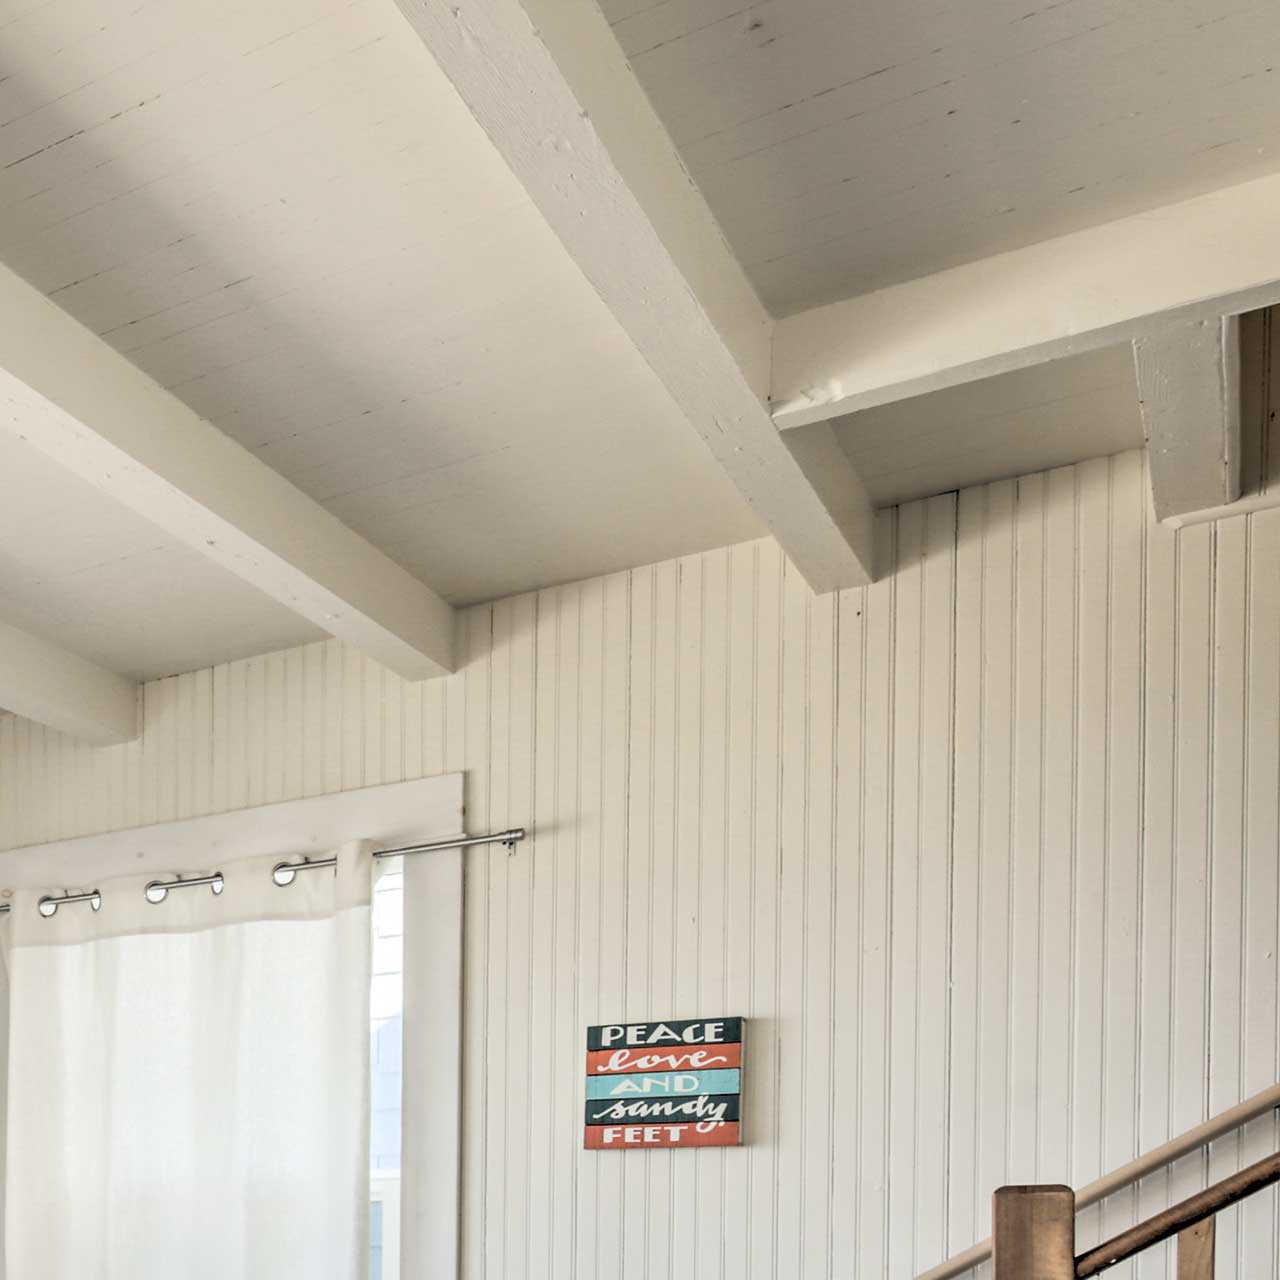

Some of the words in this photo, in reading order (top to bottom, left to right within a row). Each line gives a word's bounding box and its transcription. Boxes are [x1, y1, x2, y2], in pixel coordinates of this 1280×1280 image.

[601, 1022, 724, 1047] PEACE
[597, 1049, 727, 1072] love
[609, 1075, 699, 1095] AND
[603, 1126, 688, 1143] FEET
